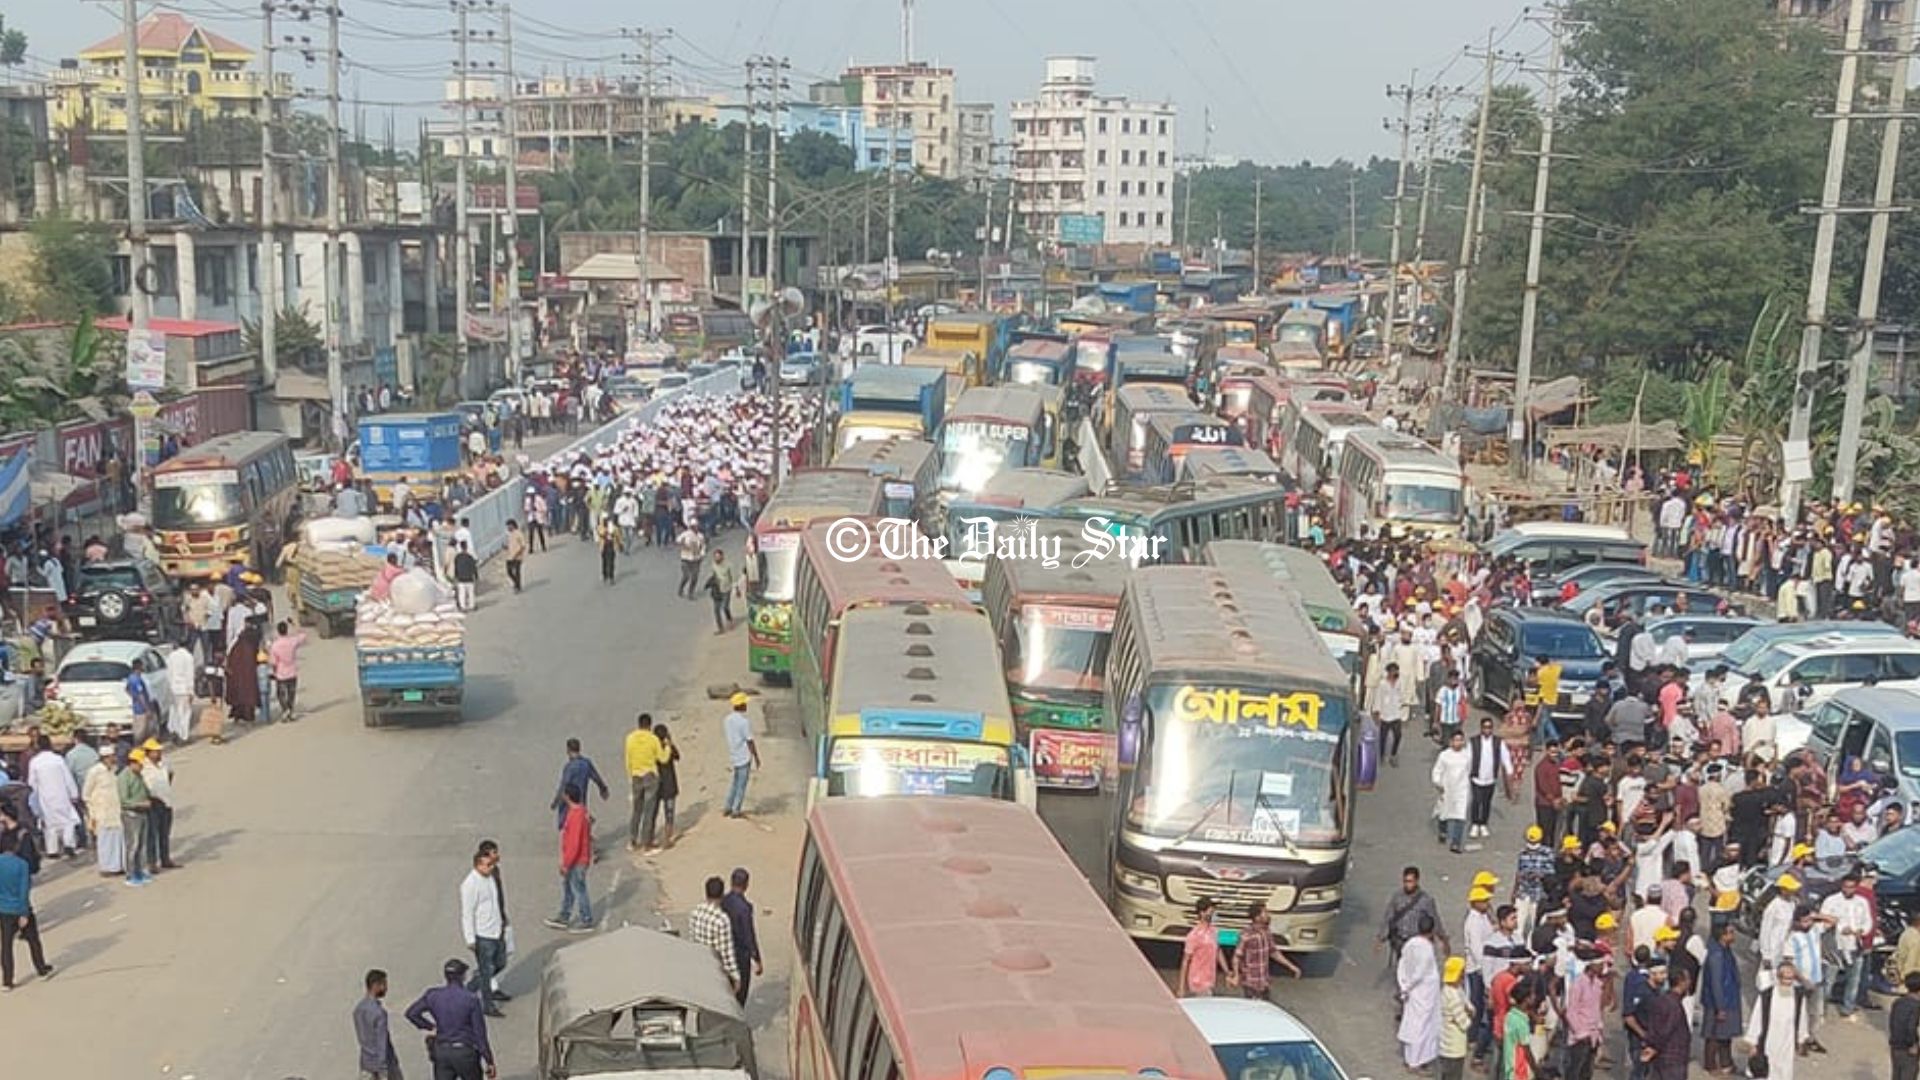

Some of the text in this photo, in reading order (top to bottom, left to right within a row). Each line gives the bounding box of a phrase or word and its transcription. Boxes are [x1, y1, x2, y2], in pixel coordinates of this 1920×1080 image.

[991, 424, 1028, 441] SUPER
[1191, 426, 1226, 443] الله
[64, 432, 102, 472] FAN
[849, 745, 958, 769] রজধানী
